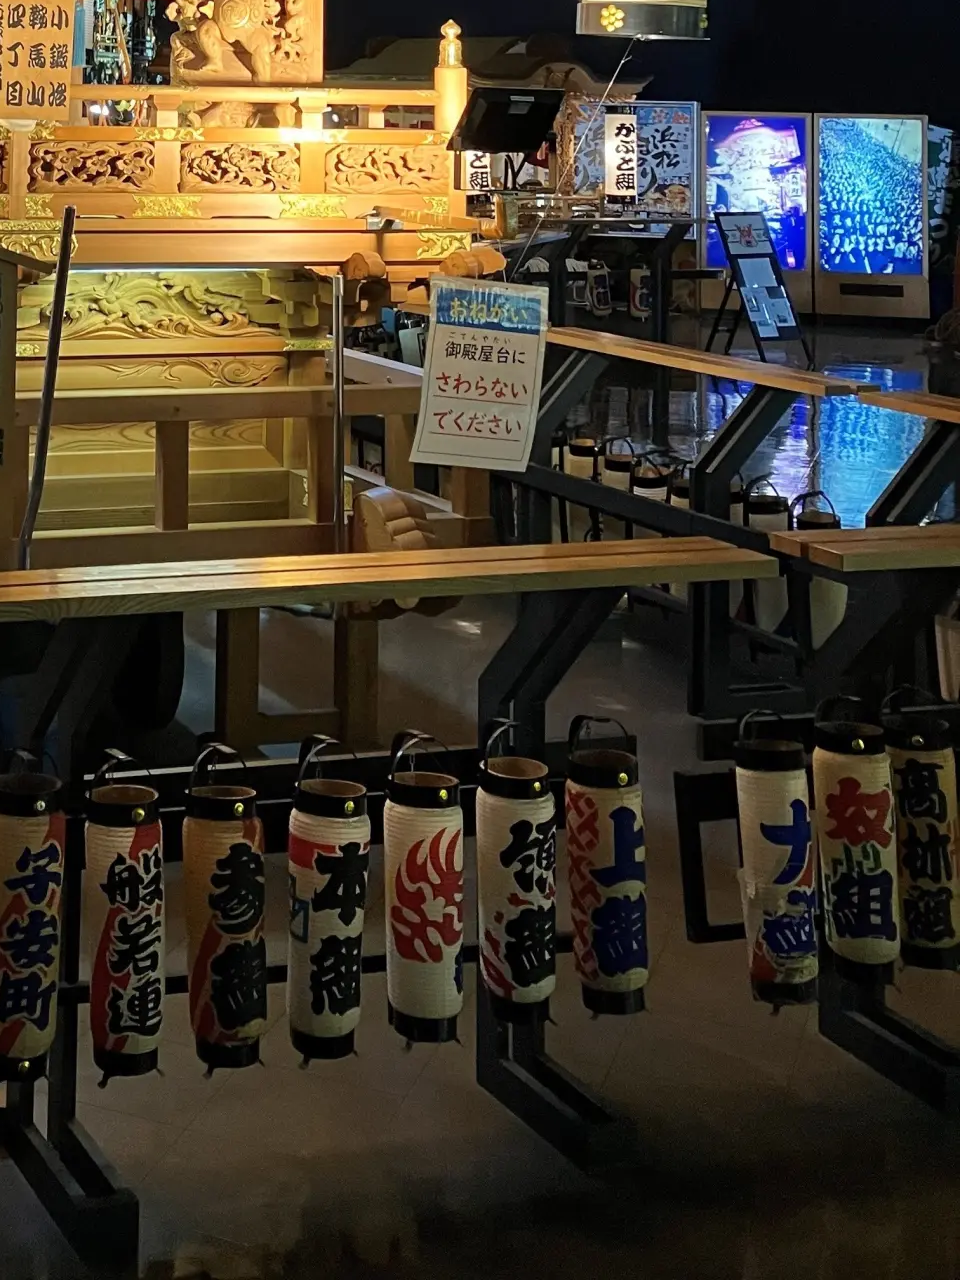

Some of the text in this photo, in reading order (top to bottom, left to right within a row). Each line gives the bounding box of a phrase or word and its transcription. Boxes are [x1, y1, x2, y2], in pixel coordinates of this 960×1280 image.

[27, 4, 48, 106] 鞍馬山
[615, 123, 636, 191] かぶと組
[650, 125, 681, 170] 浜松
[450, 297, 527, 321] おねがい
[448, 331, 511, 344] ごてんやたい
[445, 342, 526, 365] 御殿屋台に
[436, 372, 528, 399] さわらない
[433, 408, 522, 435] でください
